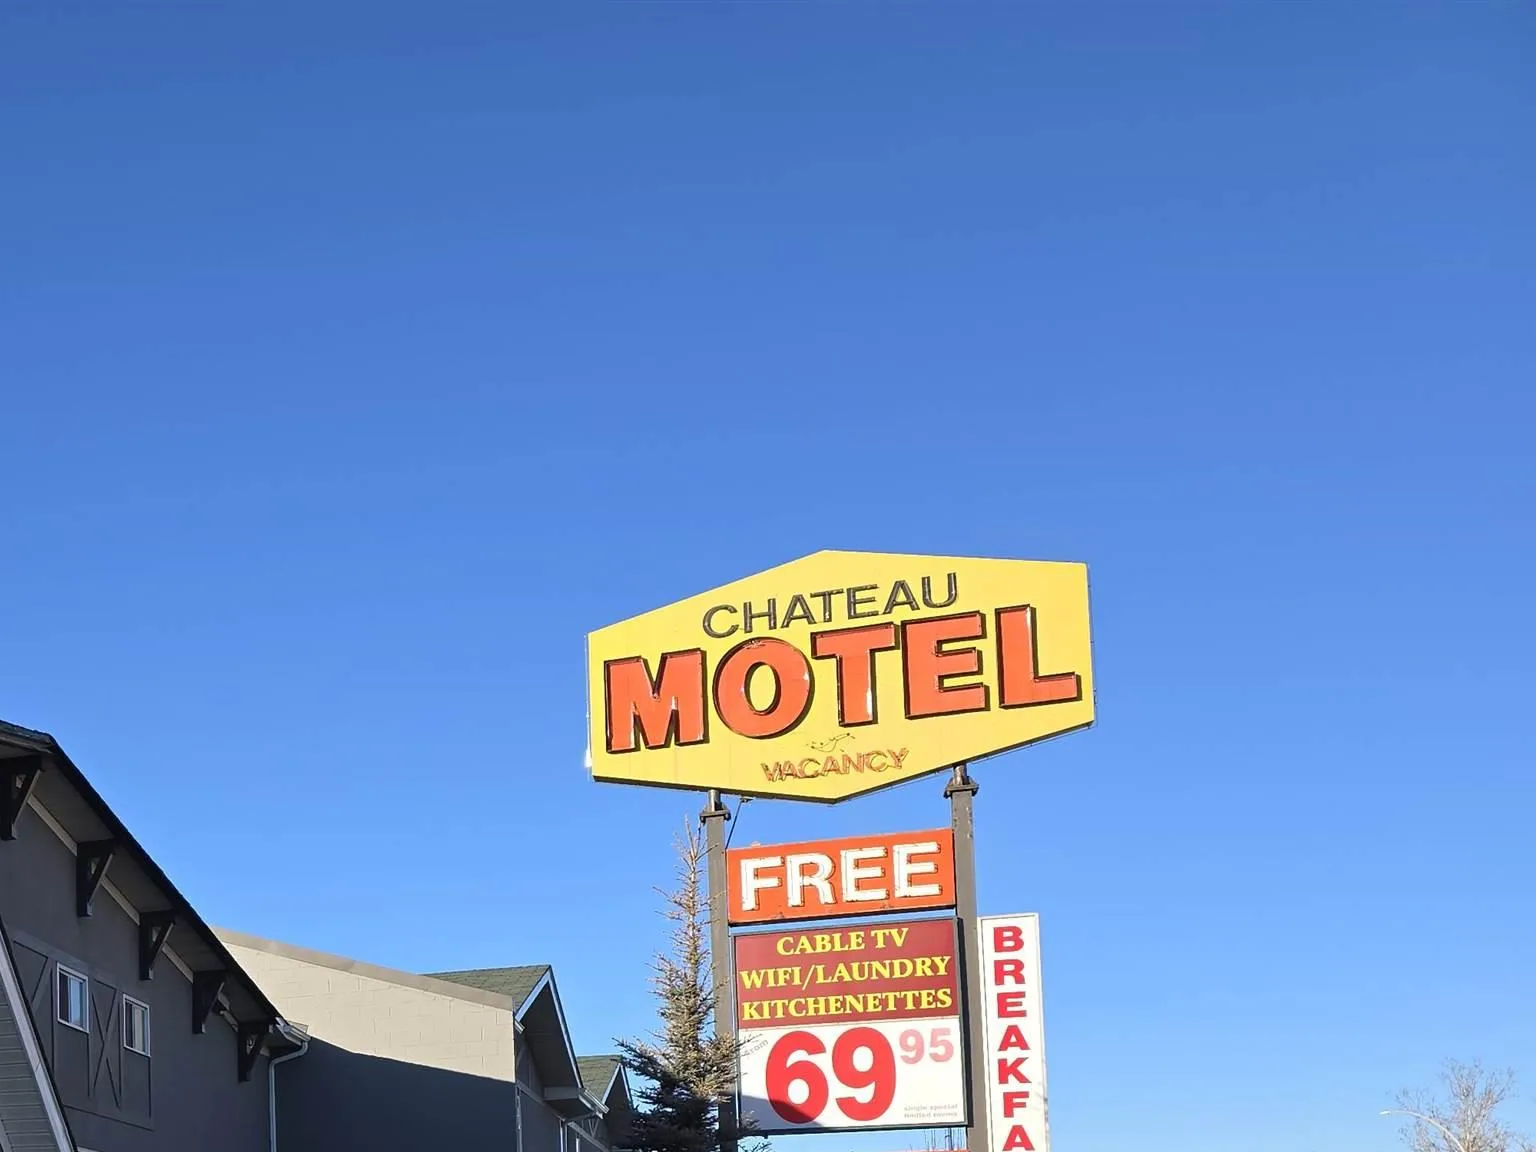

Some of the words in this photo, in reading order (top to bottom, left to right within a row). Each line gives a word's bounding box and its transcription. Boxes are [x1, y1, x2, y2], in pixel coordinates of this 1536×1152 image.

[702, 573, 958, 638] CHATEAU
[603, 604, 1082, 753] MOTEL
[761, 748, 909, 782] VACANCY
[740, 841, 941, 911] FREE
[776, 931, 866, 956] CABLE
[874, 928, 909, 949] TV
[739, 955, 952, 991] WIFI/LAUNDRY
[742, 988, 952, 1021] KITCHENETTES
[765, 1027, 896, 1124] 69
[899, 1027, 954, 1064] 95
